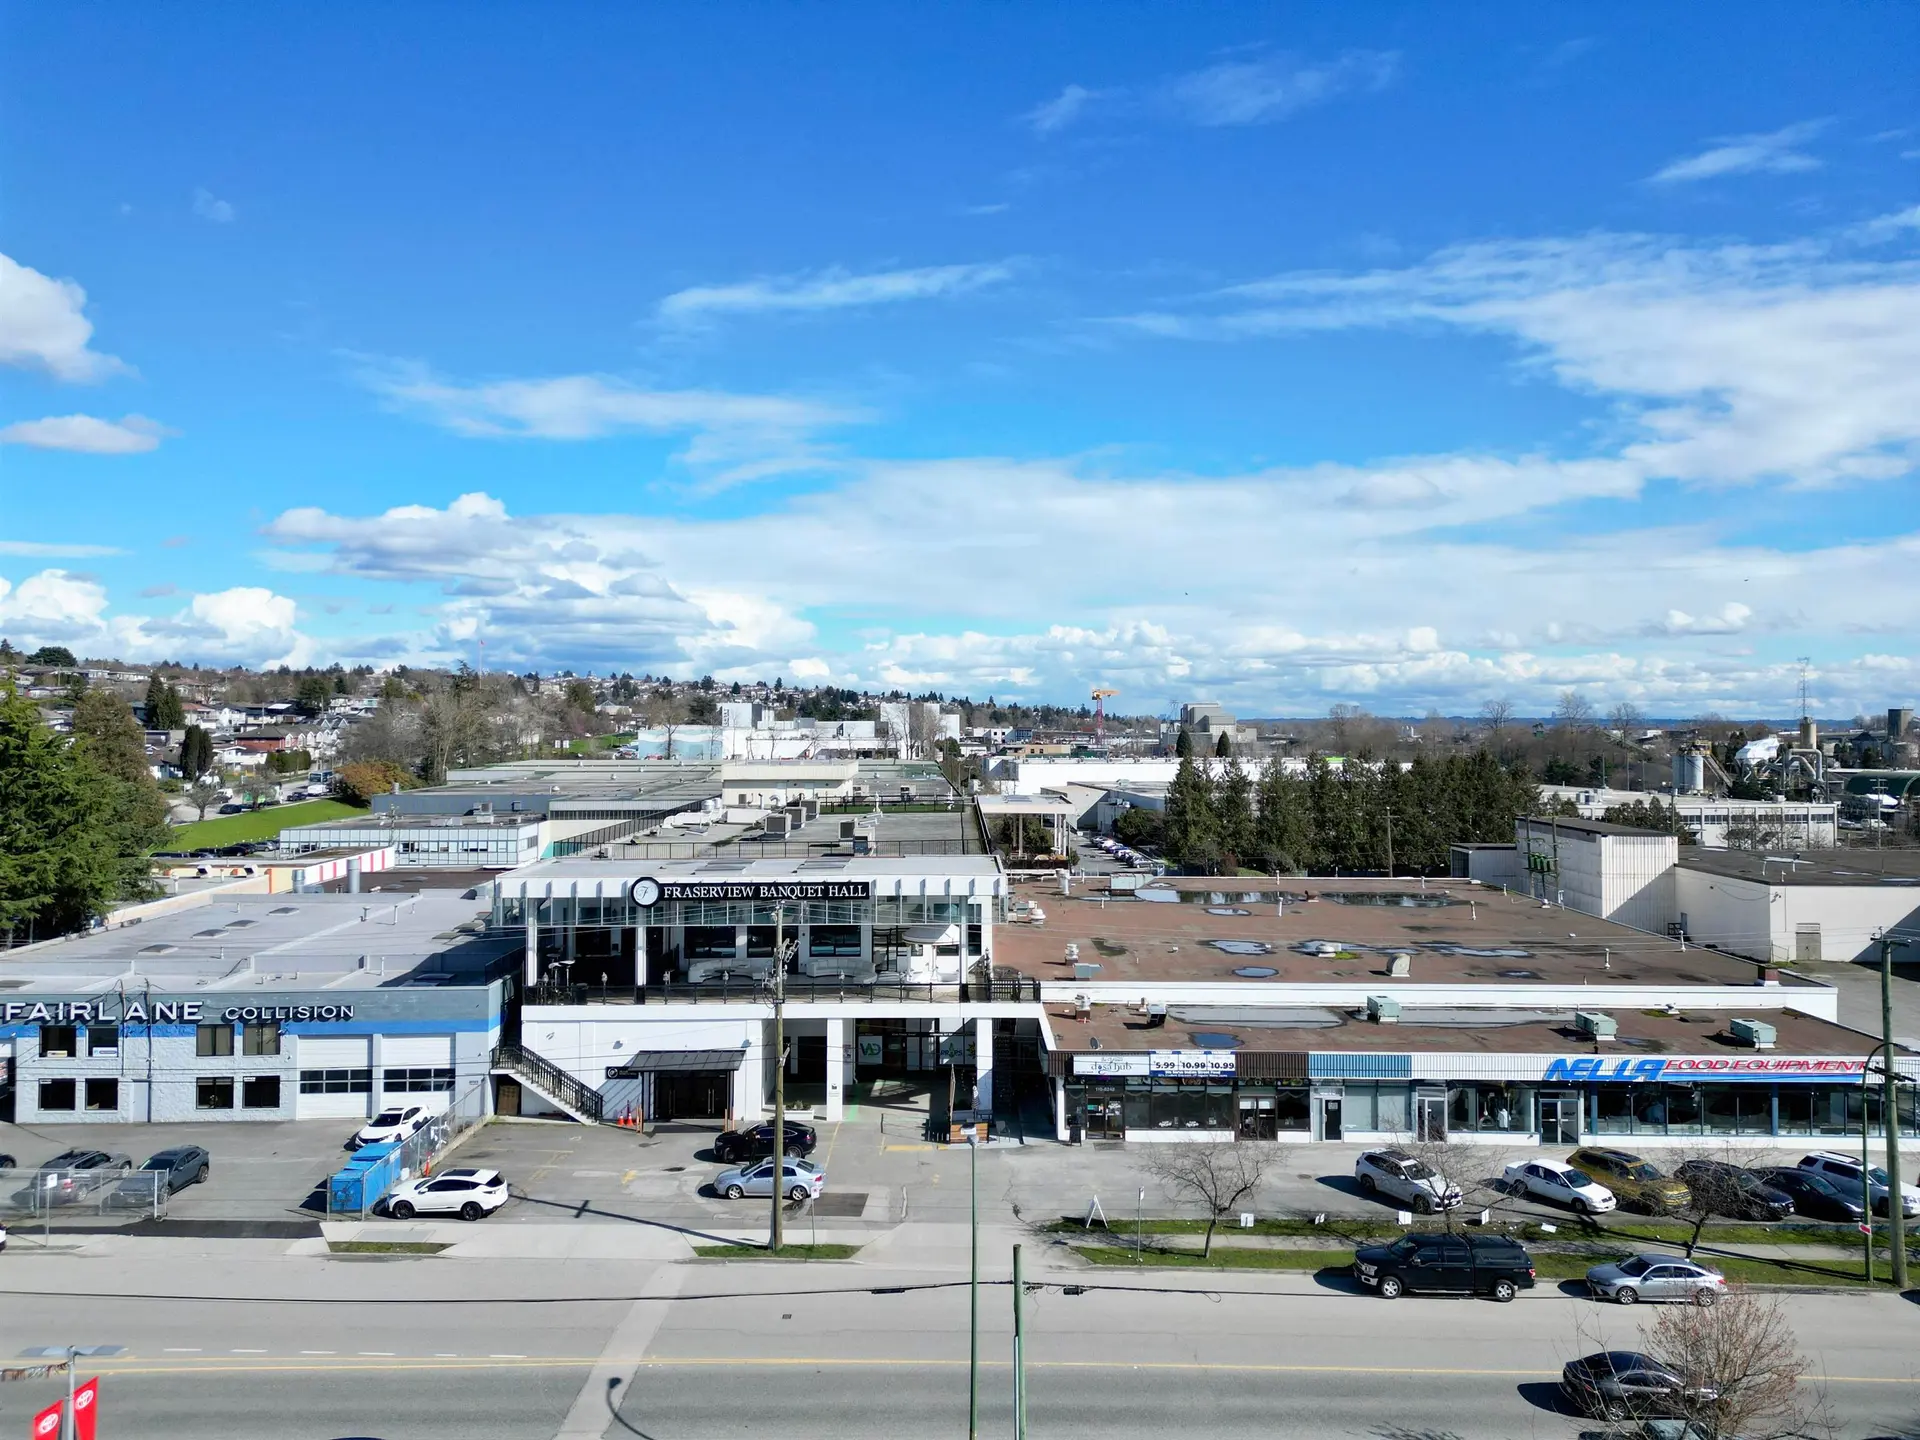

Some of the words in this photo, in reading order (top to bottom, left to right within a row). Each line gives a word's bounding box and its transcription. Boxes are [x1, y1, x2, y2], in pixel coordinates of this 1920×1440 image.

[663, 886, 755, 898] FRASERVIEW
[759, 886, 825, 899] BANQUET
[828, 884, 867, 897] HALL
[5, 1001, 204, 1021] FAIRLANE
[225, 1005, 354, 1020] COLLISION
[1544, 1058, 1667, 1080] NELLA
[1665, 1059, 1730, 1070] FOOD
[1733, 1060, 1867, 1070] EQUIPMENT
